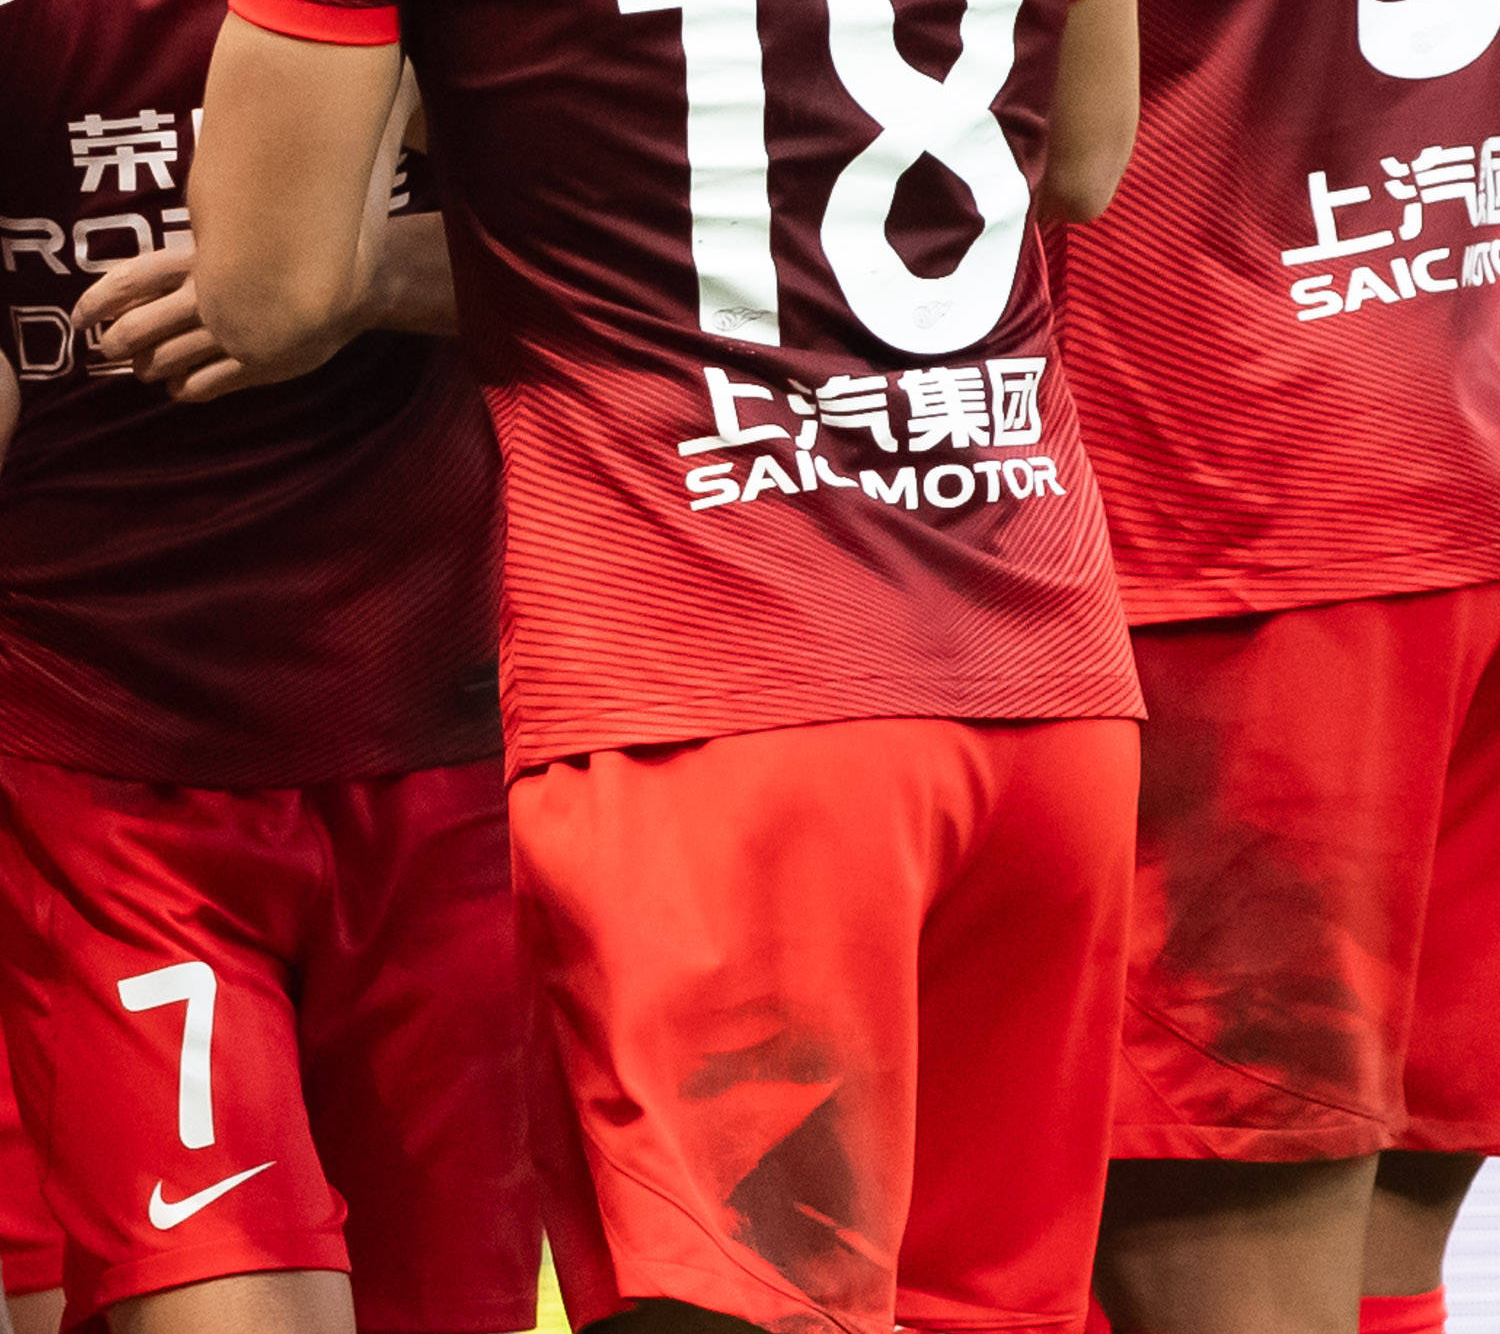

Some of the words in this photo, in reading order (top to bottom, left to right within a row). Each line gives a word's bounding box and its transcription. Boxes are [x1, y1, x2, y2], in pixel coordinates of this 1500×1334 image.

[68, 108, 204, 192] 荣
[1290, 247, 1458, 322] SAIC
[677, 357, 1046, 457] 上汽集团
[859, 456, 1067, 510] MOTOR
[117, 960, 217, 1150] 7
